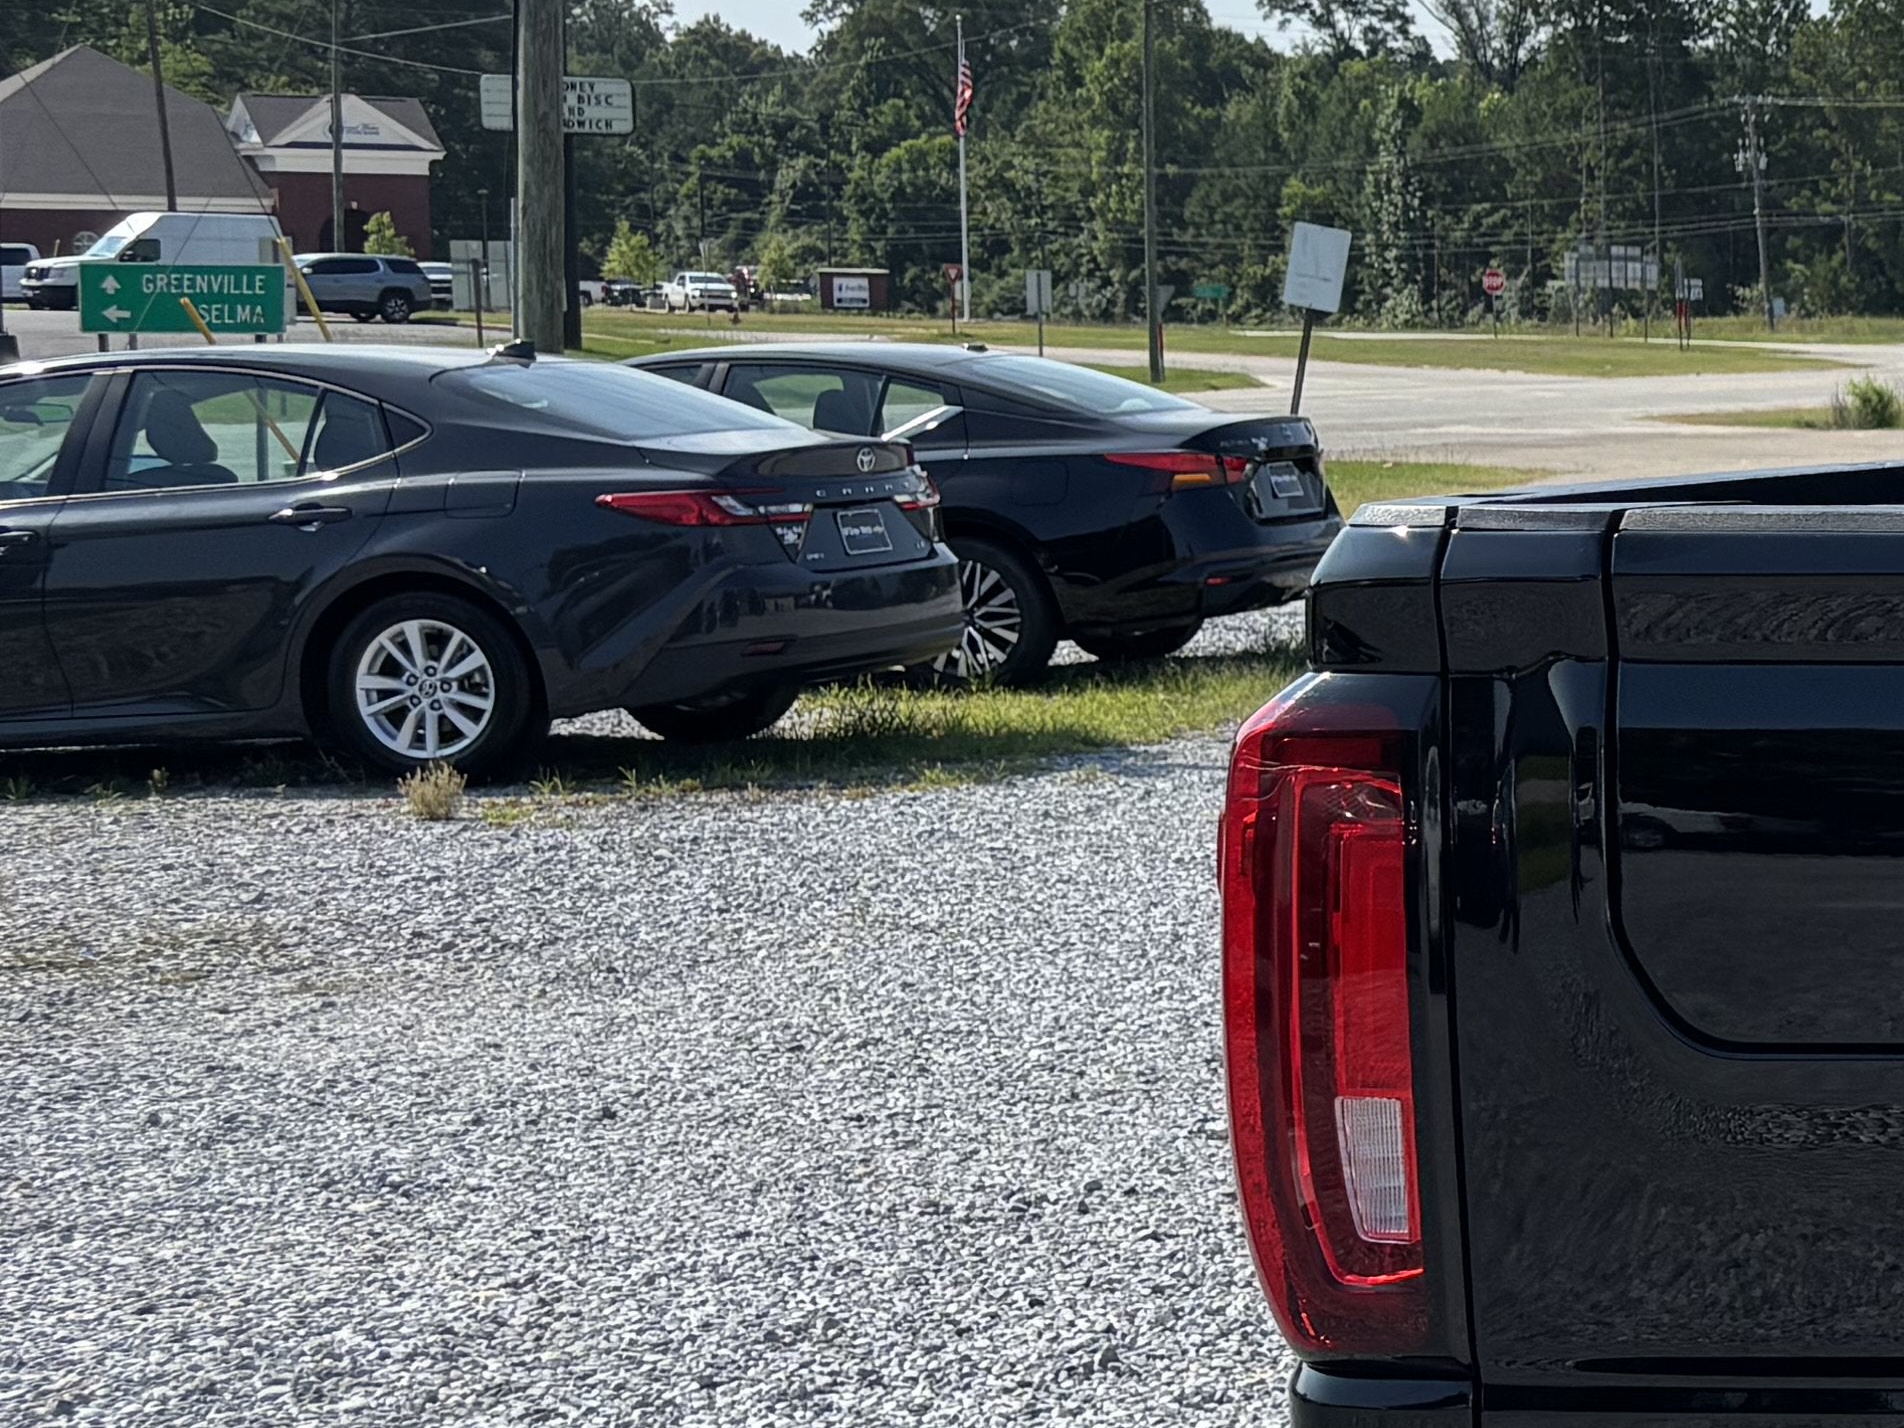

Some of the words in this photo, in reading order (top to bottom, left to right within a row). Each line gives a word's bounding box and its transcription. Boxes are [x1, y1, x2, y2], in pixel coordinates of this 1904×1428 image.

[562, 81, 595, 93] ONEY
[142, 274, 266, 294] GREENVILLE
[199, 304, 264, 324] SELMA
